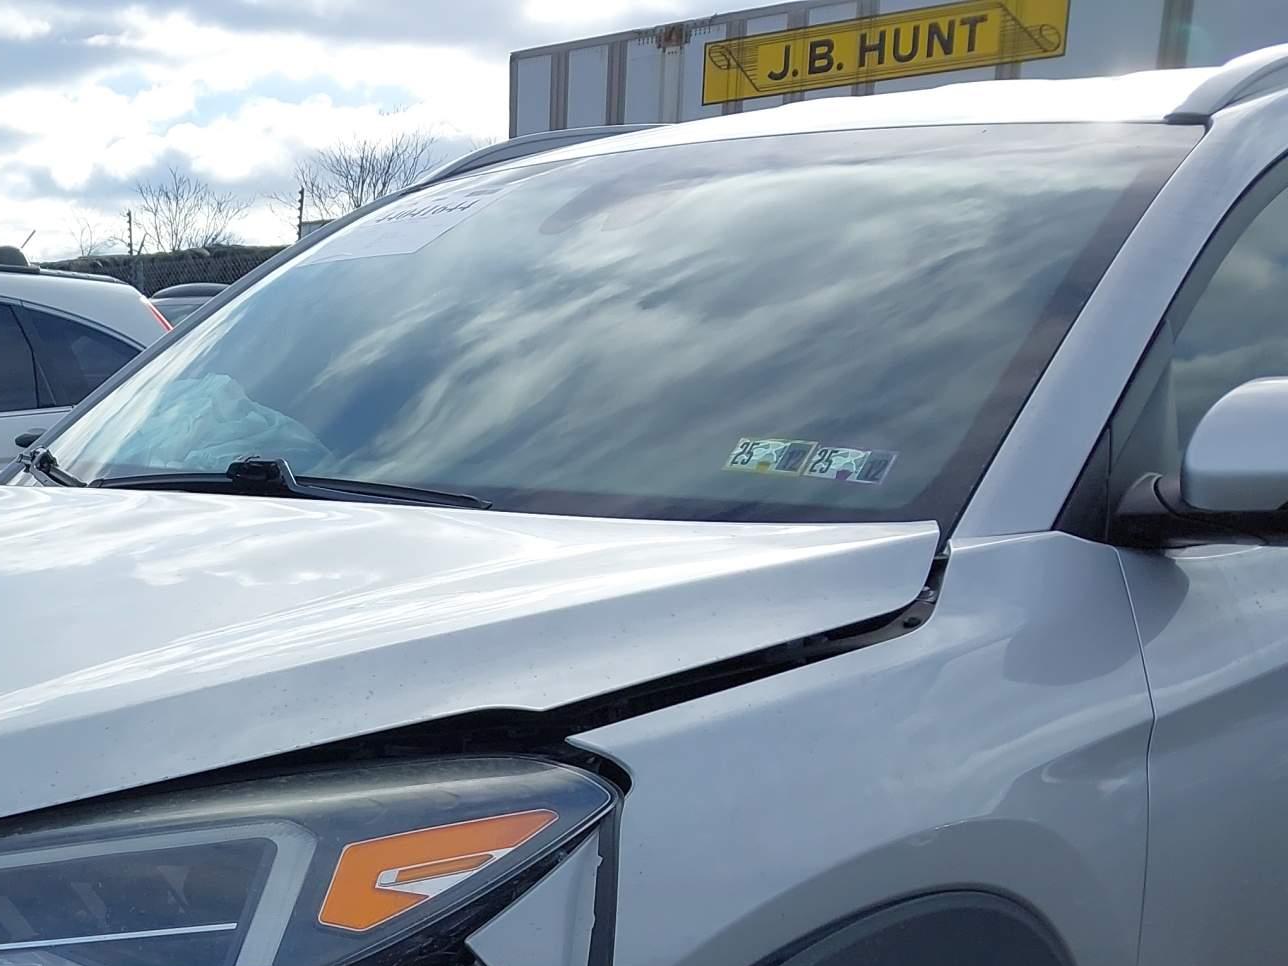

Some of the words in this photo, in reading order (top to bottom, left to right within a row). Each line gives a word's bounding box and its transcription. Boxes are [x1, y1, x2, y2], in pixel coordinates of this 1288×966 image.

[858, 14, 988, 69] HUNT
[731, 441, 760, 465] 25
[811, 448, 839, 474] 25
